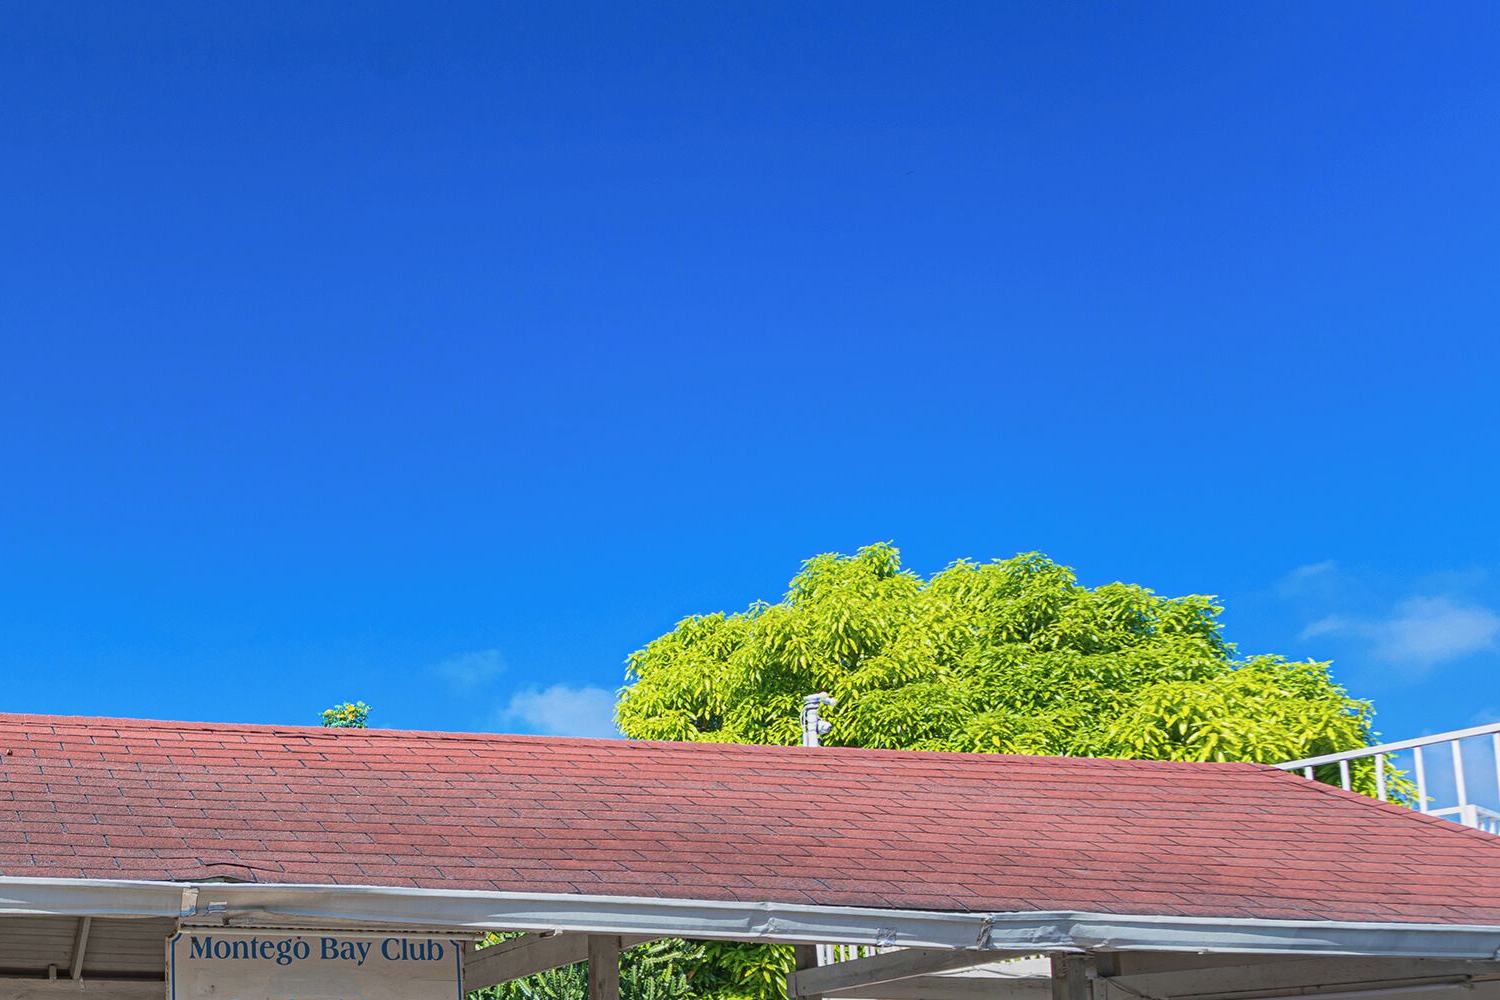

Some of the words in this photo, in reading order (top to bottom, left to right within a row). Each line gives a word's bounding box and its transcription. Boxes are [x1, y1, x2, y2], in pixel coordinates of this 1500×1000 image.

[189, 936, 310, 966] Montego
[320, 937, 372, 967] Bay
[380, 938, 445, 961] Club
